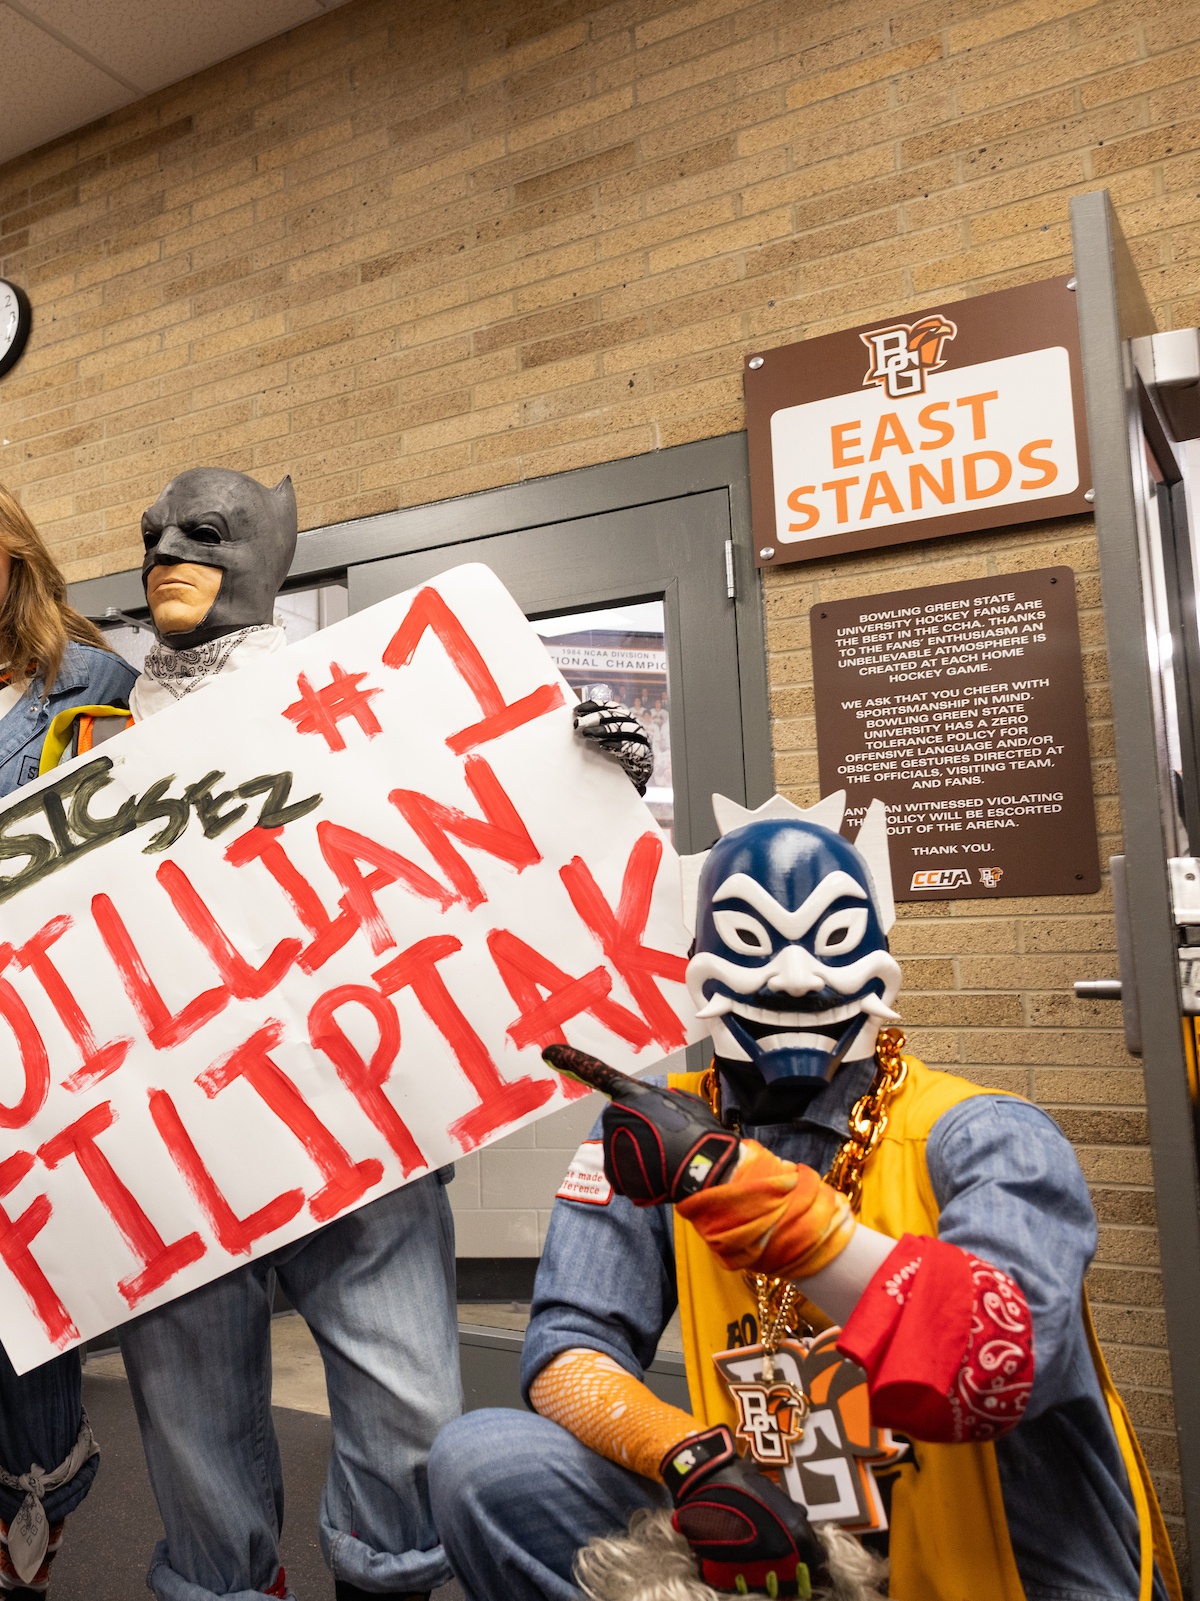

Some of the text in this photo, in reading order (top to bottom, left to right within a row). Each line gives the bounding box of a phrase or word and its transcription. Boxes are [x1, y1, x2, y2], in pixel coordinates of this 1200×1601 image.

[830, 390, 999, 469] EAST
[786, 439, 1059, 532] STANDS
[836, 599, 1043, 636] UNIVERSITY HOCKEY FANS ARE
[858, 591, 1016, 623] BOWLING GREEN STATE
[834, 610, 1046, 647] THE BEST IN THE CCHA. THANKS
[838, 647, 856, 657] TO
[858, 643, 883, 654] THE
[927, 625, 1018, 645] ENTHUSIASM
[1021, 621, 1043, 633] AN
[562, 648, 581, 656] 1984
[584, 649, 608, 658] NCAA
[611, 651, 649, 660] DIVISION
[837, 632, 1047, 668] UNBELIEVABLE ATMOSPHERE IS
[858, 646, 1024, 676] CREATED AT EACH HOME
[282, 586, 564, 756] #1
[888, 662, 992, 683] HOCKEY GAME.
[840, 677, 1050, 710] WE ASK THAT YOU CHEER WITH
[855, 691, 1034, 719] SPORTSMANSHIP IN MIND.
[863, 714, 1028, 739] UNIVERSITY HAS A ZERO
[865, 703, 1025, 728] BOWLING GREEN STATE
[844, 734, 1053, 762] OFFENSIVE LANGUAGE AND/OR
[864, 725, 1028, 750] TOLERANCE POLICY FOR
[836, 744, 1065, 774] OBSCENE GESTURES DIRECTED AT
[845, 757, 1055, 784] THE OFFICIALS, VISITING TEAM,
[911, 775, 985, 790] AND FANS.
[885, 804, 902, 814] AN
[903, 797, 984, 812] WITNESSED
[985, 791, 1064, 806] VIOLATING
[886, 813, 926, 825] OLICY
[928, 810, 962, 821] WILL
[965, 808, 984, 819] BE
[986, 803, 1062, 817] ESCORTED
[886, 818, 1019, 836] OUT OF THE ARENA.
[910, 842, 995, 856] THANK YOU.
[914, 871, 969, 887] CCHA
[578, 1172, 603, 1182] made
